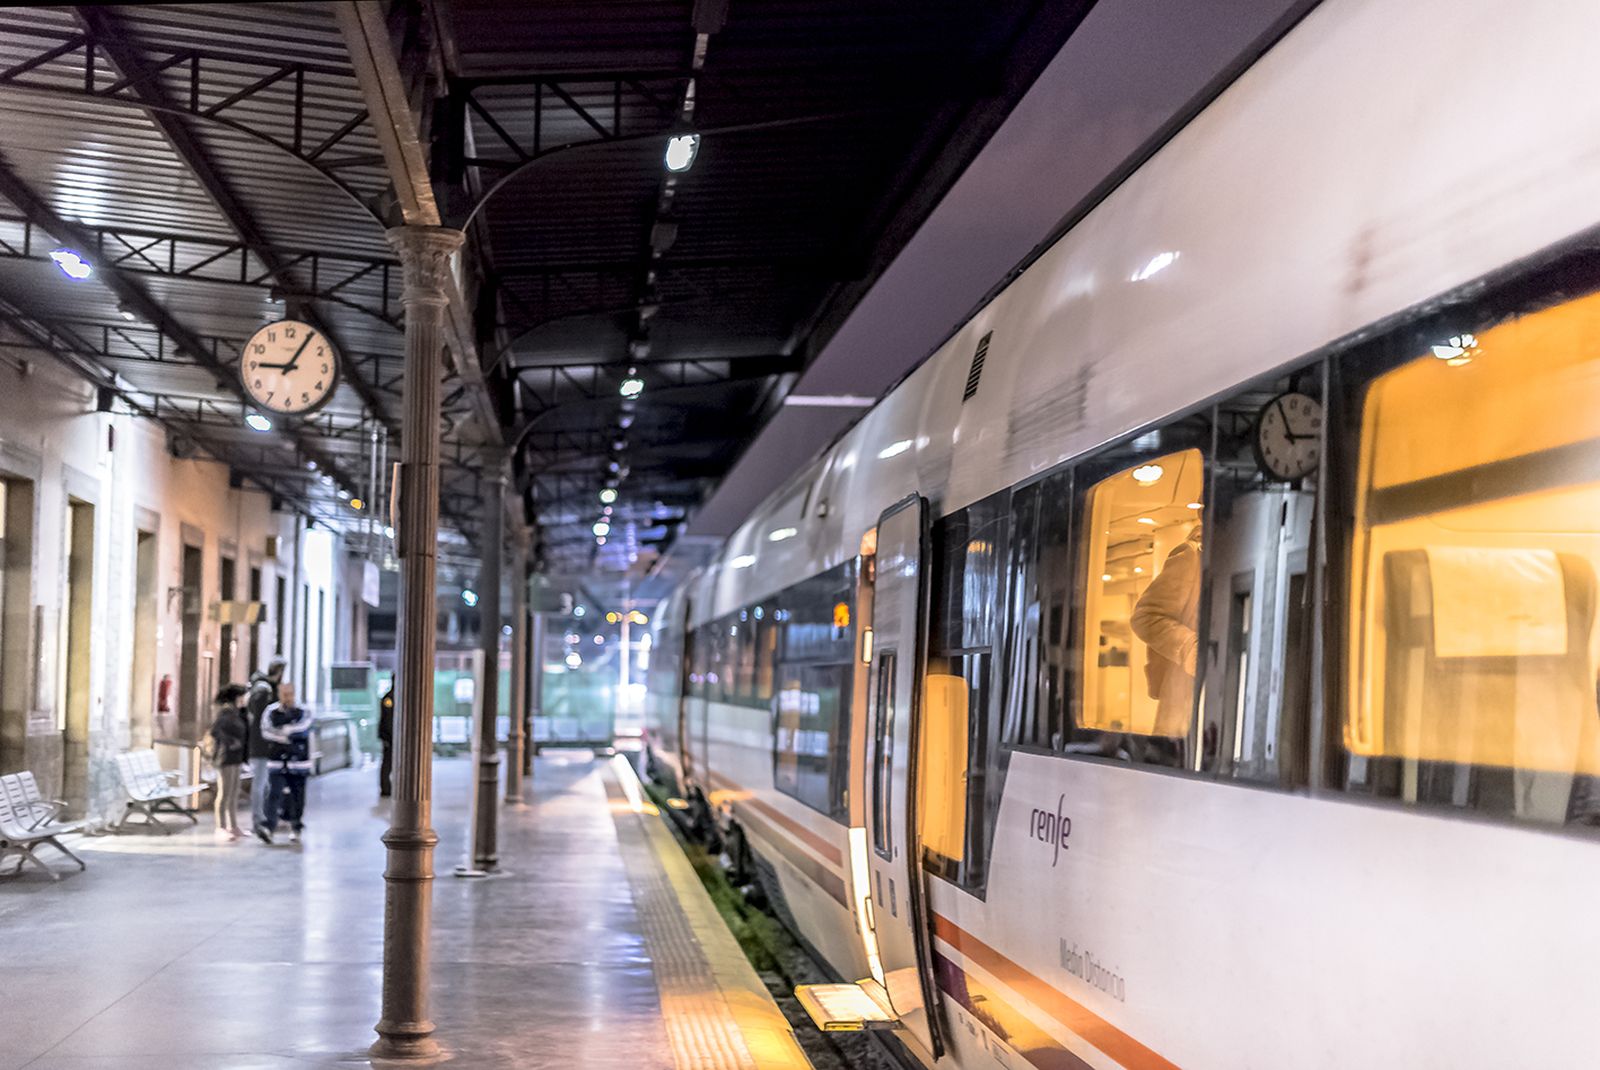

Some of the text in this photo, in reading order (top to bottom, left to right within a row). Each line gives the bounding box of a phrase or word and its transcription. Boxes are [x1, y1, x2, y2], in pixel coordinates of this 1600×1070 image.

[267, 331, 276, 342] 11
[285, 327, 296, 339] 12
[254, 344, 266, 354] 10
[317, 346, 324, 356] 2
[250, 361, 257, 371] 9
[321, 364, 328, 374] 3
[314, 381, 323, 390] 4
[267, 392, 274, 403] 7
[284, 397, 291, 408] 6
[302, 392, 309, 403] 5
[1030, 793, 1071, 867] renfe
